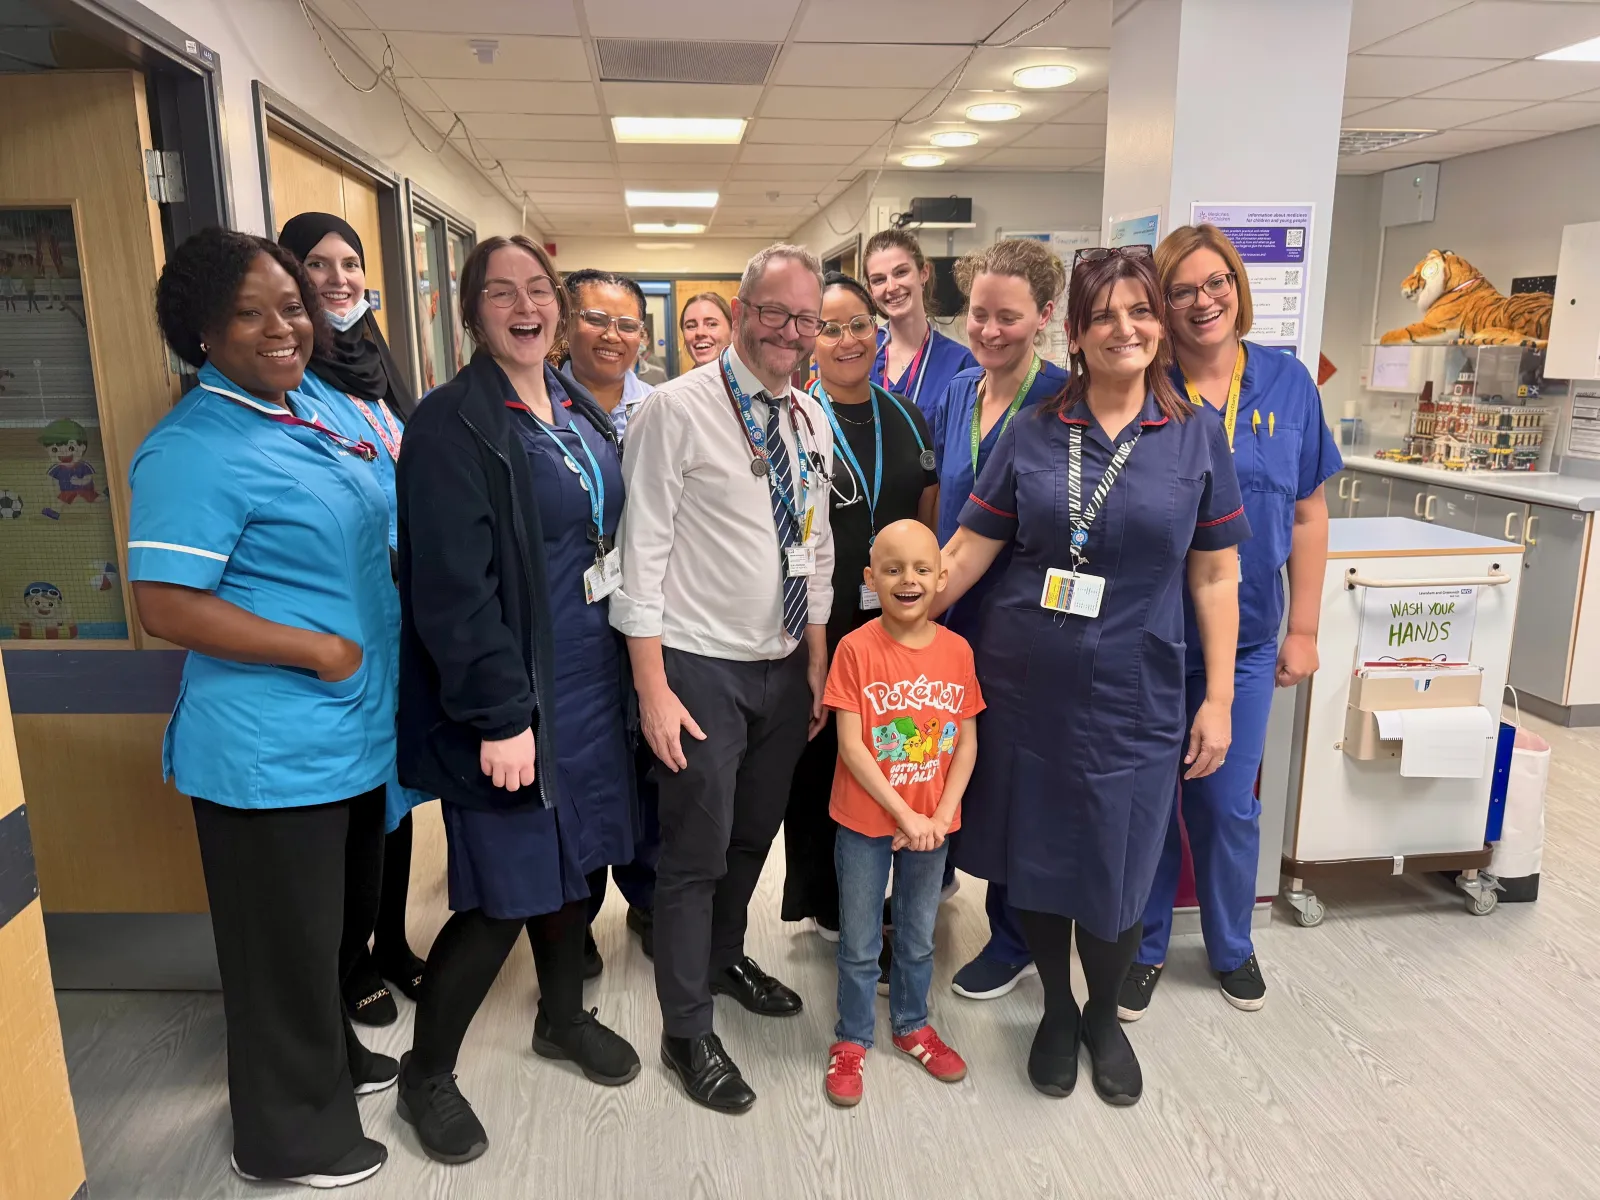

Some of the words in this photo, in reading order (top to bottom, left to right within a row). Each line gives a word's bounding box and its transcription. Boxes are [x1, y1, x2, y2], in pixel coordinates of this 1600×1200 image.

[726, 368, 736, 383] NHS
[971, 407, 979, 447] CONSULTANT
[799, 458, 807, 473] NHS
[1390, 600, 1423, 618] WASH
[1428, 602, 1455, 616] YOUR
[1388, 621, 1451, 647] HANDS
[890, 763, 918, 773] GOTTA
[909, 767, 936, 784] ALL!
